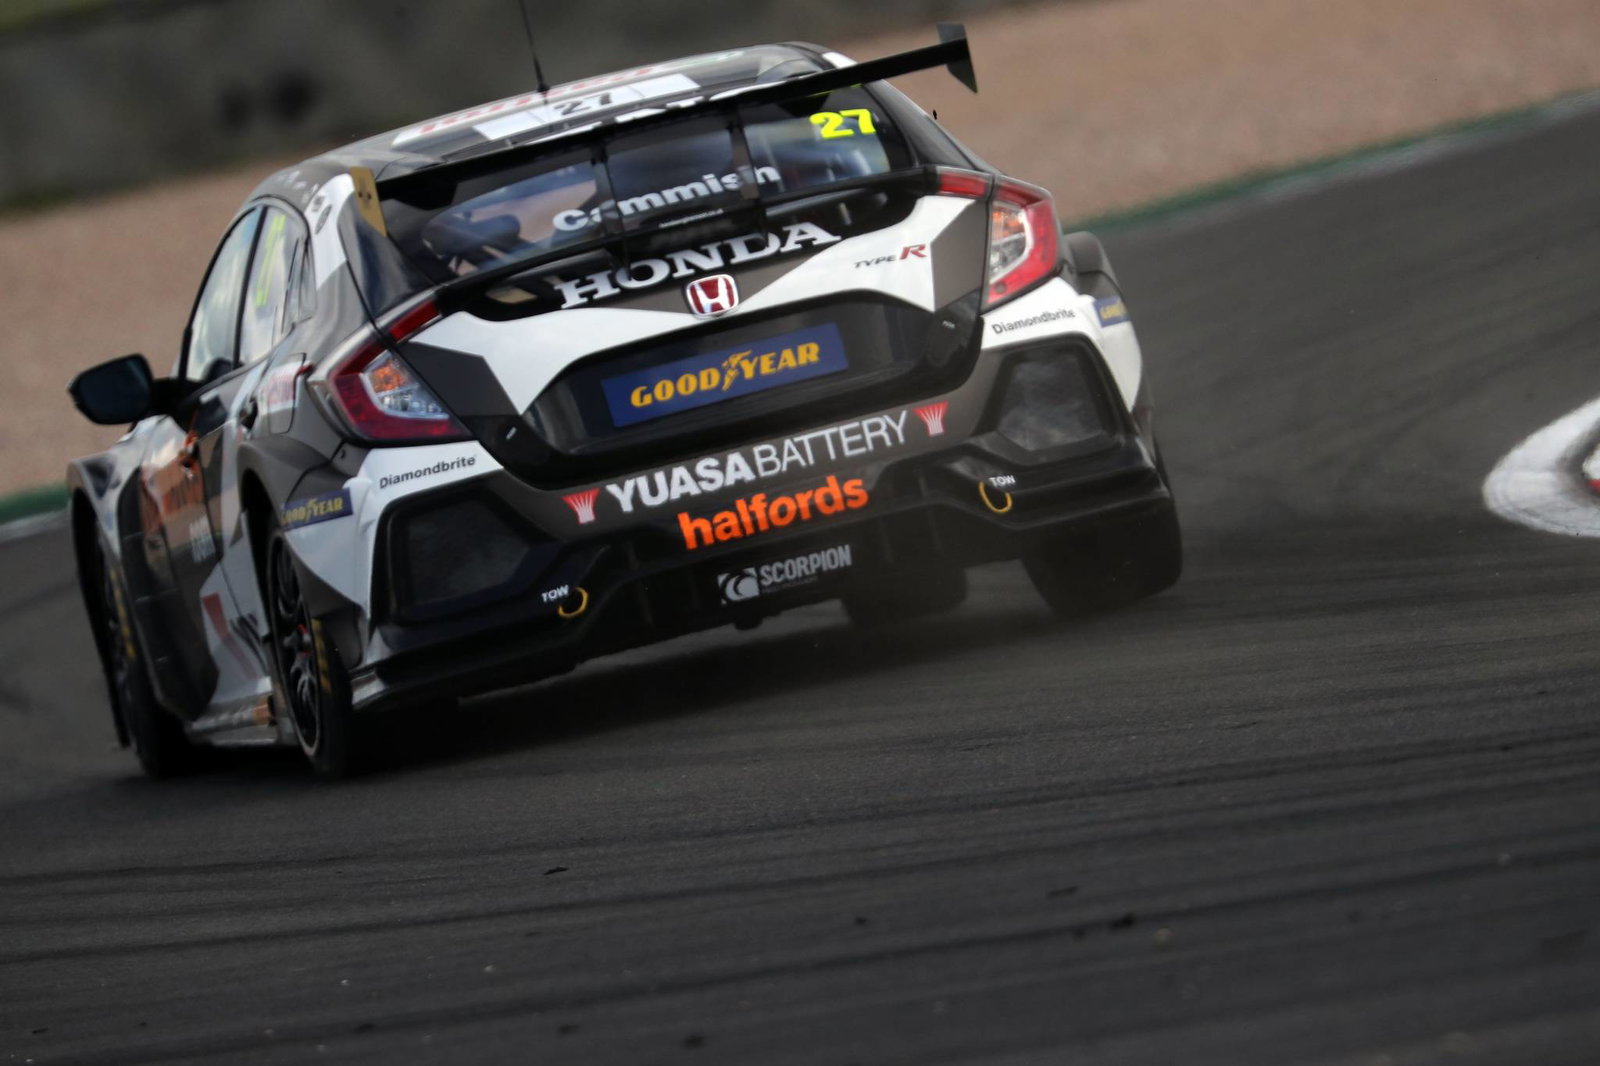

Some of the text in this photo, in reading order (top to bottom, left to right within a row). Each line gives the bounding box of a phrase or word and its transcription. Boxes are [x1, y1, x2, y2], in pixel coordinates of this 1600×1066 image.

[809, 108, 877, 140] 27
[552, 164, 782, 232] Cammish
[554, 221, 841, 309] HONDA
[854, 243, 928, 269] TYPE R
[991, 308, 1077, 335] Diamondbrite
[378, 455, 477, 490] Diamondbrite
[606, 410, 908, 514] YUASA BATTERY
[988, 475, 1016, 488] TOW
[677, 474, 869, 550] halfords
[759, 543, 853, 587] SCORPION
[541, 584, 569, 603] TOW
